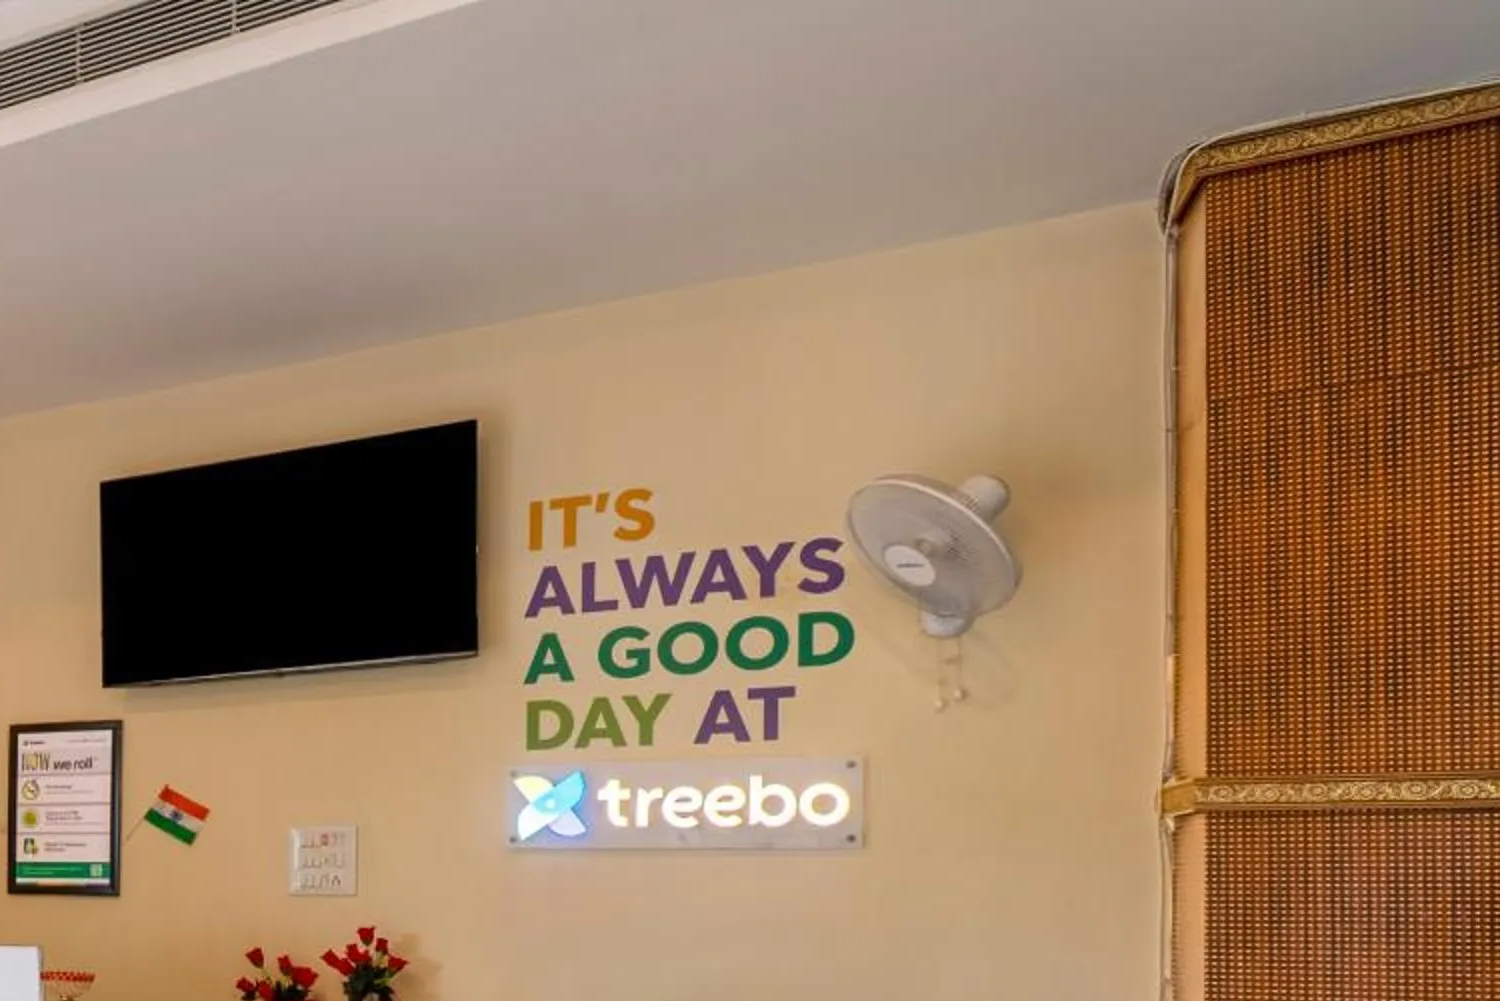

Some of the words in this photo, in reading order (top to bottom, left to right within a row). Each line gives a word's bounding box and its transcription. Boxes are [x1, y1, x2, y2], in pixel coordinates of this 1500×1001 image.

[528, 489, 655, 551] IT'S
[524, 538, 846, 618] ALWAYS
[524, 632, 575, 684] A
[598, 611, 854, 678] GOOD
[525, 693, 672, 751] DAY
[693, 686, 796, 744] AT
[597, 775, 850, 828] treebo
